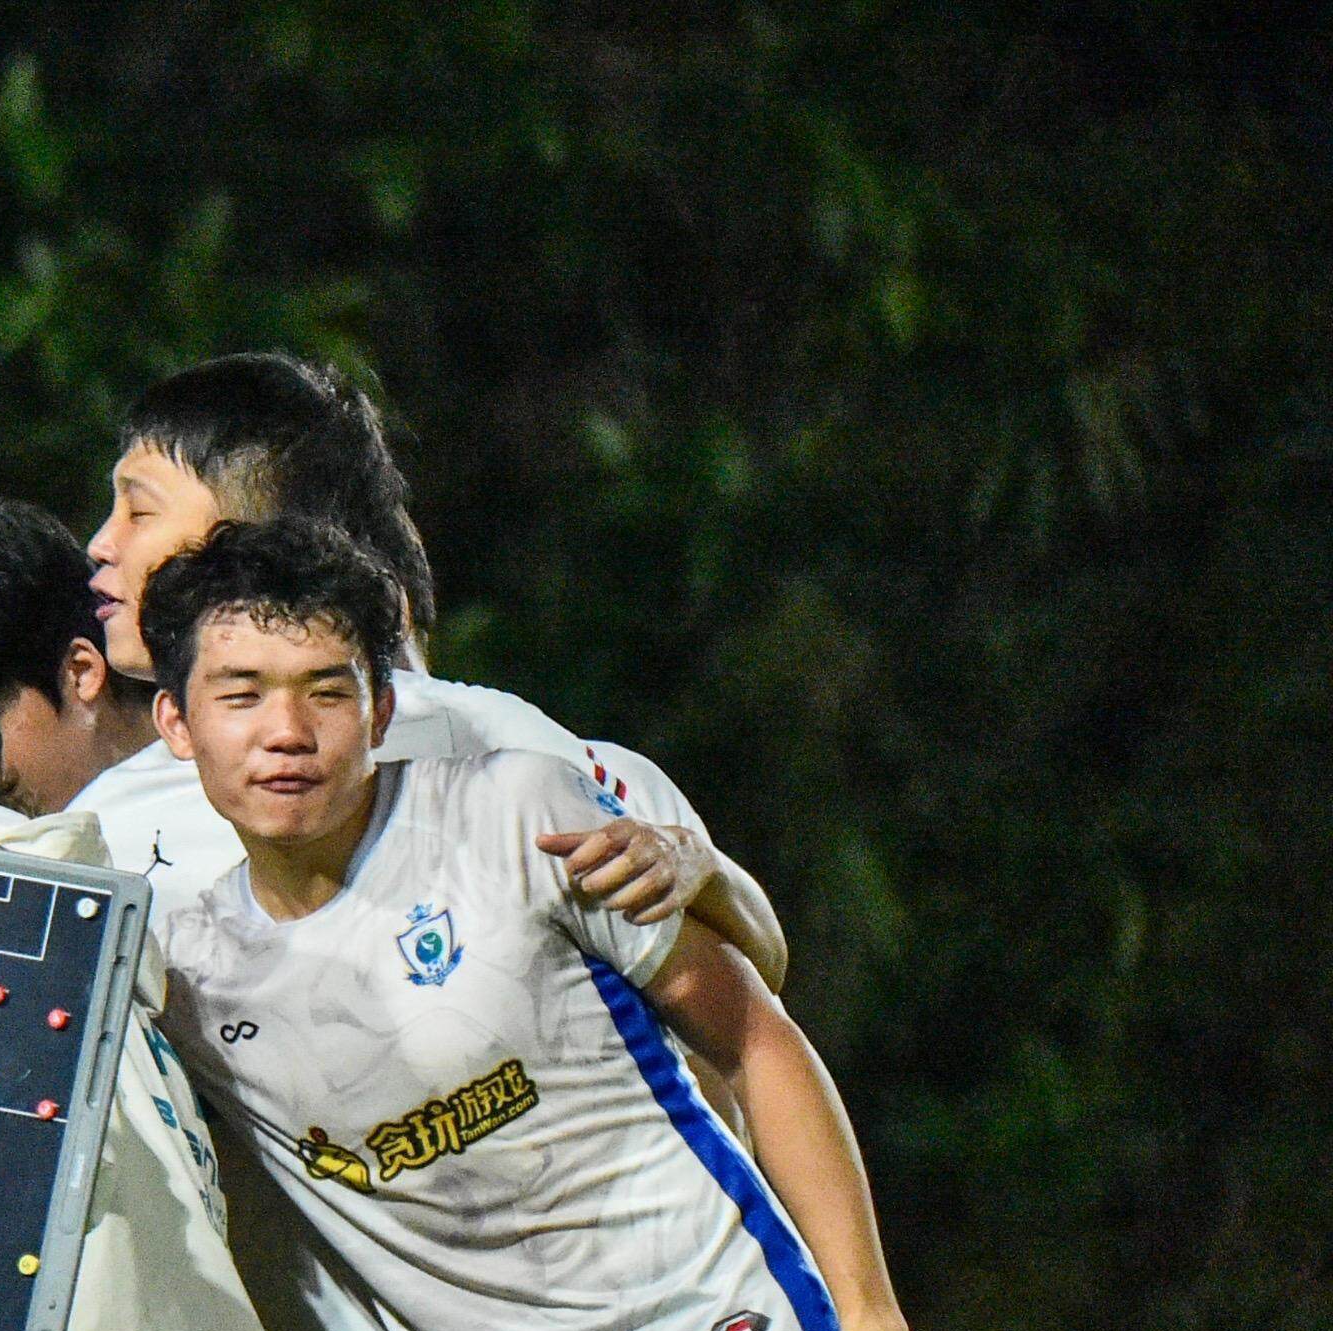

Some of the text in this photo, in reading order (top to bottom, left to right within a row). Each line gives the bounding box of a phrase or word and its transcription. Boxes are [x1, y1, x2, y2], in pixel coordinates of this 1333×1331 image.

[368, 1062, 532, 1179] 贪玩游戏
[461, 1093, 535, 1142] TanWan.com
